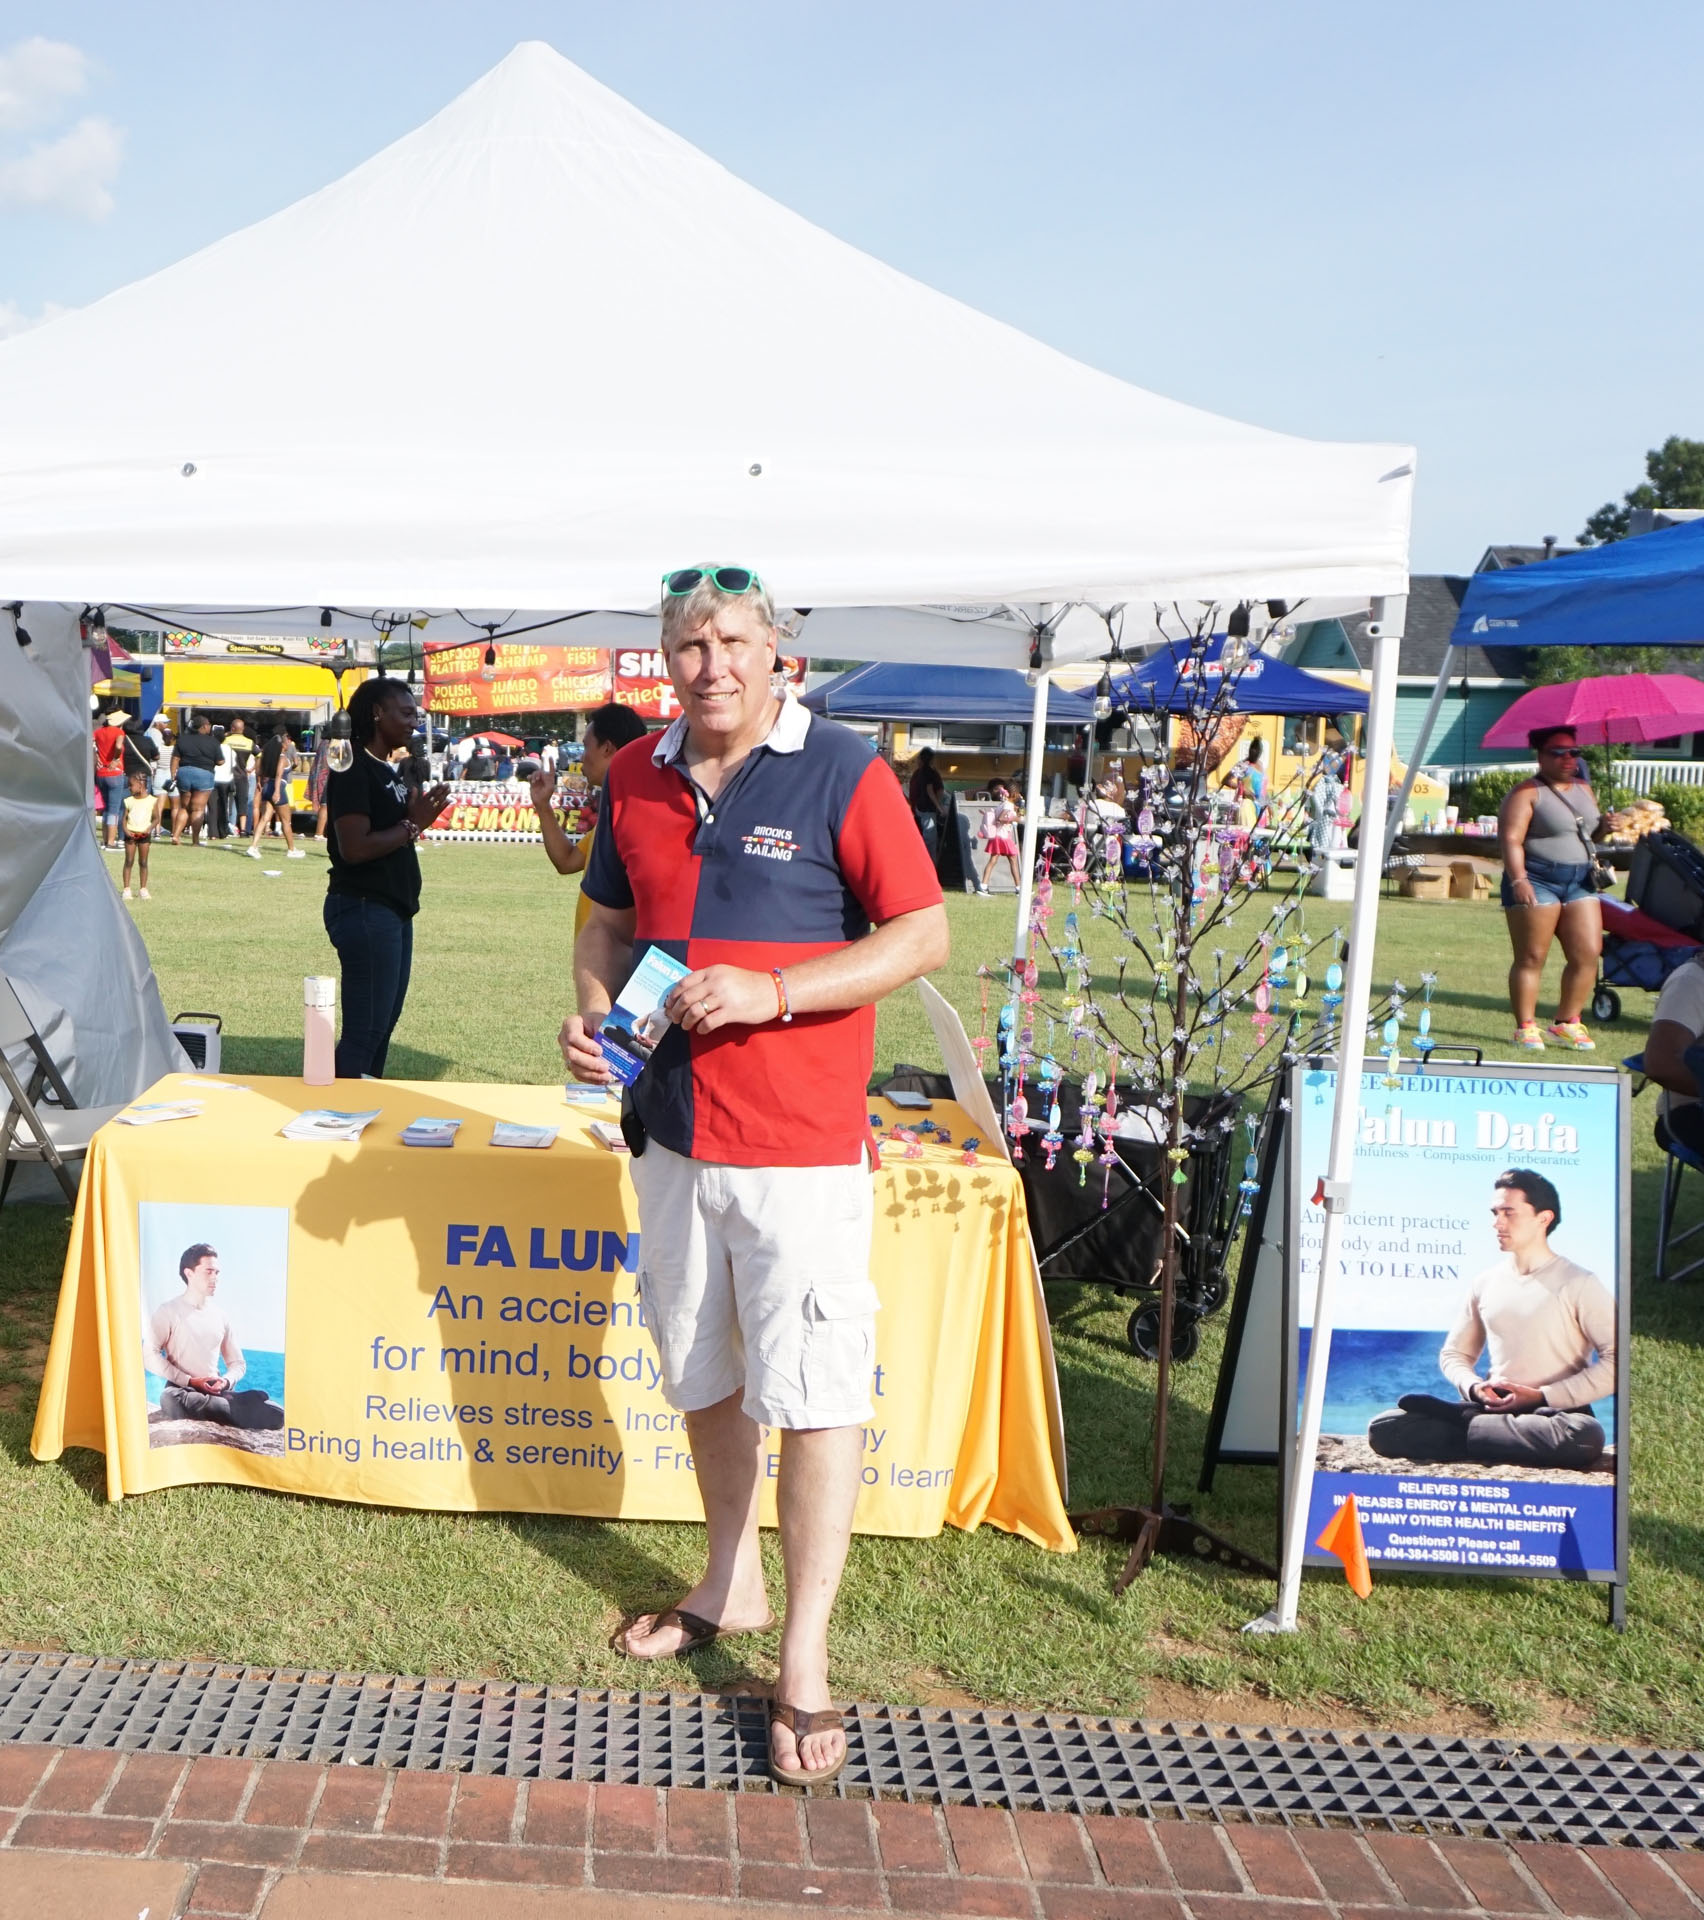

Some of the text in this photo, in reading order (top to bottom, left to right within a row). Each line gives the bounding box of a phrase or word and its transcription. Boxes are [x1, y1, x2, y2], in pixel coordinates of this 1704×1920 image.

[495, 653, 548, 669] SHRIMP
[567, 651, 597, 665] FISH
[430, 661, 479, 676] PLATTERS
[434, 684, 472, 698] POLISH
[490, 678, 538, 694] JUMBO
[553, 688, 604, 703] FINGERS
[615, 682, 665, 706] Fried
[429, 697, 479, 712] SAUSAGE
[491, 692, 538, 708] WINGS
[753, 825, 793, 841] BROOKS
[743, 843, 793, 862] SAILING
[1523, 1080, 1589, 1100] CLASS
[1475, 1110, 1580, 1154] Dafa
[1423, 1149, 1496, 1164] Compassion
[1506, 1152, 1581, 1167] Forbearance
[1342, 1210, 1395, 1228] ncient
[1401, 1214, 1471, 1233] practice
[445, 1224, 517, 1269] FA
[1340, 1235, 1373, 1257] ody
[1378, 1239, 1411, 1254] and
[1416, 1239, 1467, 1256] mind.
[1357, 1260, 1384, 1276] TO
[1391, 1262, 1460, 1280] LEARN
[427, 1285, 484, 1321] An
[371, 1336, 426, 1371] for
[439, 1340, 551, 1384] mind,
[365, 1394, 494, 1426] Relieves
[504, 1400, 593, 1429] stress
[287, 1427, 361, 1463] Bring
[372, 1434, 463, 1462] health
[473, 1438, 496, 1464] &
[505, 1443, 624, 1476] serenity
[1398, 1482, 1511, 1499] RELIEVES STRESS
[1405, 1498, 1457, 1512] ENERGY
[1458, 1502, 1469, 1513] &
[1470, 1503, 1522, 1516] MENTAL
[1523, 1506, 1578, 1519] CLARITY
[1371, 1512, 1409, 1526] MANY
[1410, 1514, 1453, 1527] OTHER
[1454, 1517, 1504, 1531] HEALTH
[1505, 1520, 1567, 1534] BENEFITS
[1388, 1533, 1521, 1552] Questions? Please call
[1480, 1553, 1558, 1567] 404-384-5509
